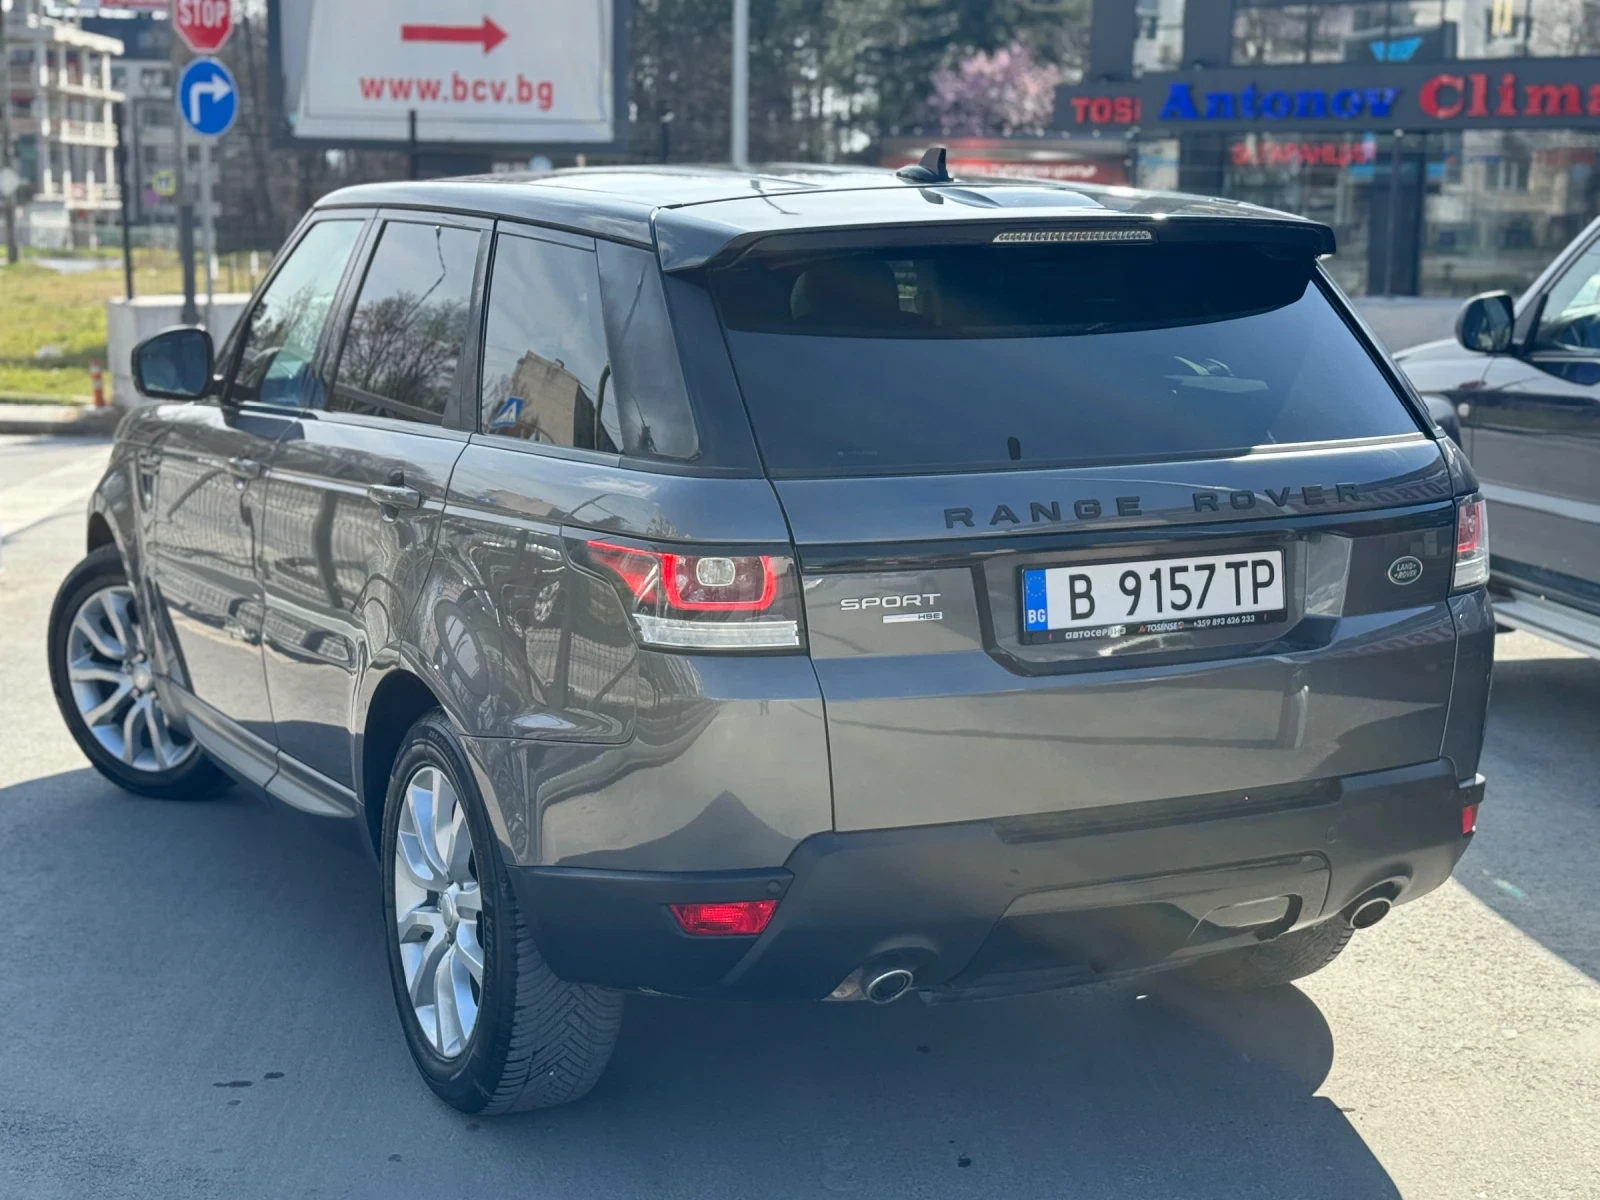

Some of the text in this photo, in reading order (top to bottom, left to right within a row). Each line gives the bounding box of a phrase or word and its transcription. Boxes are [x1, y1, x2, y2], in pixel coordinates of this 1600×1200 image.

[179, 0, 226, 28] STOP
[359, 71, 554, 111] www.bcv.bg
[1157, 81, 1400, 120] Antonov
[943, 495, 1144, 529] RANGE
[1191, 482, 1362, 513] ROVER
[1396, 562, 1413, 571] LAND
[1397, 569, 1418, 579] ROVER
[1068, 558, 1276, 621] B 9157 TP
[840, 593, 942, 611] SPORT
[1027, 608, 1047, 625] BG
[1193, 614, 1256, 628] +359 893 626 233
